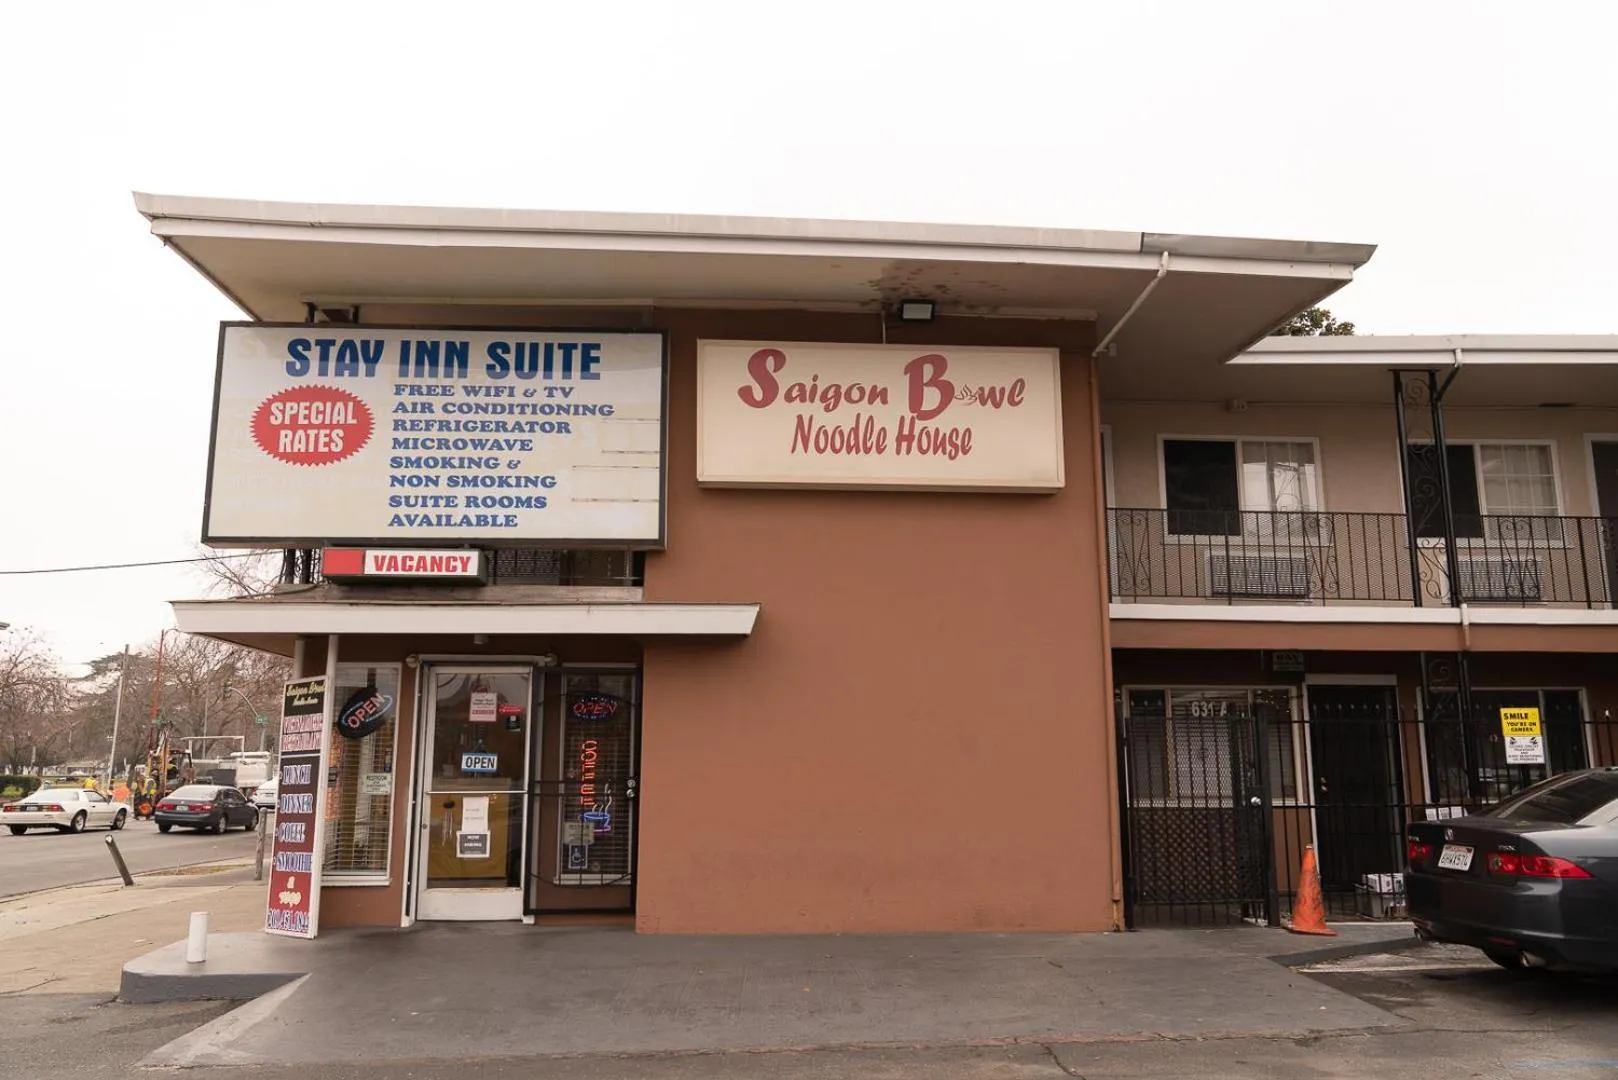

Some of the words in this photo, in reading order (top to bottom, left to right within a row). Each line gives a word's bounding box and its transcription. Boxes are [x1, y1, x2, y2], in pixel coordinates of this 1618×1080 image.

[285, 338, 384, 378] STAY
[400, 340, 469, 379] INN
[486, 342, 601, 381] SUITE
[737, 348, 889, 413] Saigon
[393, 384, 455, 398] FREE
[461, 385, 515, 398] WIFI
[522, 387, 537, 399] &
[543, 386, 575, 399] TV
[269, 402, 357, 426] SPECIAL
[392, 402, 437, 415] AIR
[441, 403, 615, 417] CONDITIONING
[392, 419, 572, 434] REFRIGERATOR
[278, 429, 344, 453] RATES
[391, 437, 533, 452] MICROWAVE
[791, 413, 887, 456] Noodle
[895, 413, 973, 461] House
[389, 456, 501, 470] SMOKING
[506, 459, 521, 470] &
[389, 475, 440, 488] NON
[446, 475, 557, 489] SMOKING
[388, 495, 458, 509] SUITE
[464, 496, 548, 509] ROOMS
[387, 514, 519, 528] AVAILABLE
[372, 555, 472, 573] VACANCY
[347, 692, 385, 728] OPEN
[573, 702, 618, 715] OPEN
[1191, 701, 1214, 717] 631
[1220, 701, 1228, 717] A
[1503, 712, 1529, 720] SMILE
[465, 756, 495, 768] OPEN
[280, 793, 313, 813] DINNER
